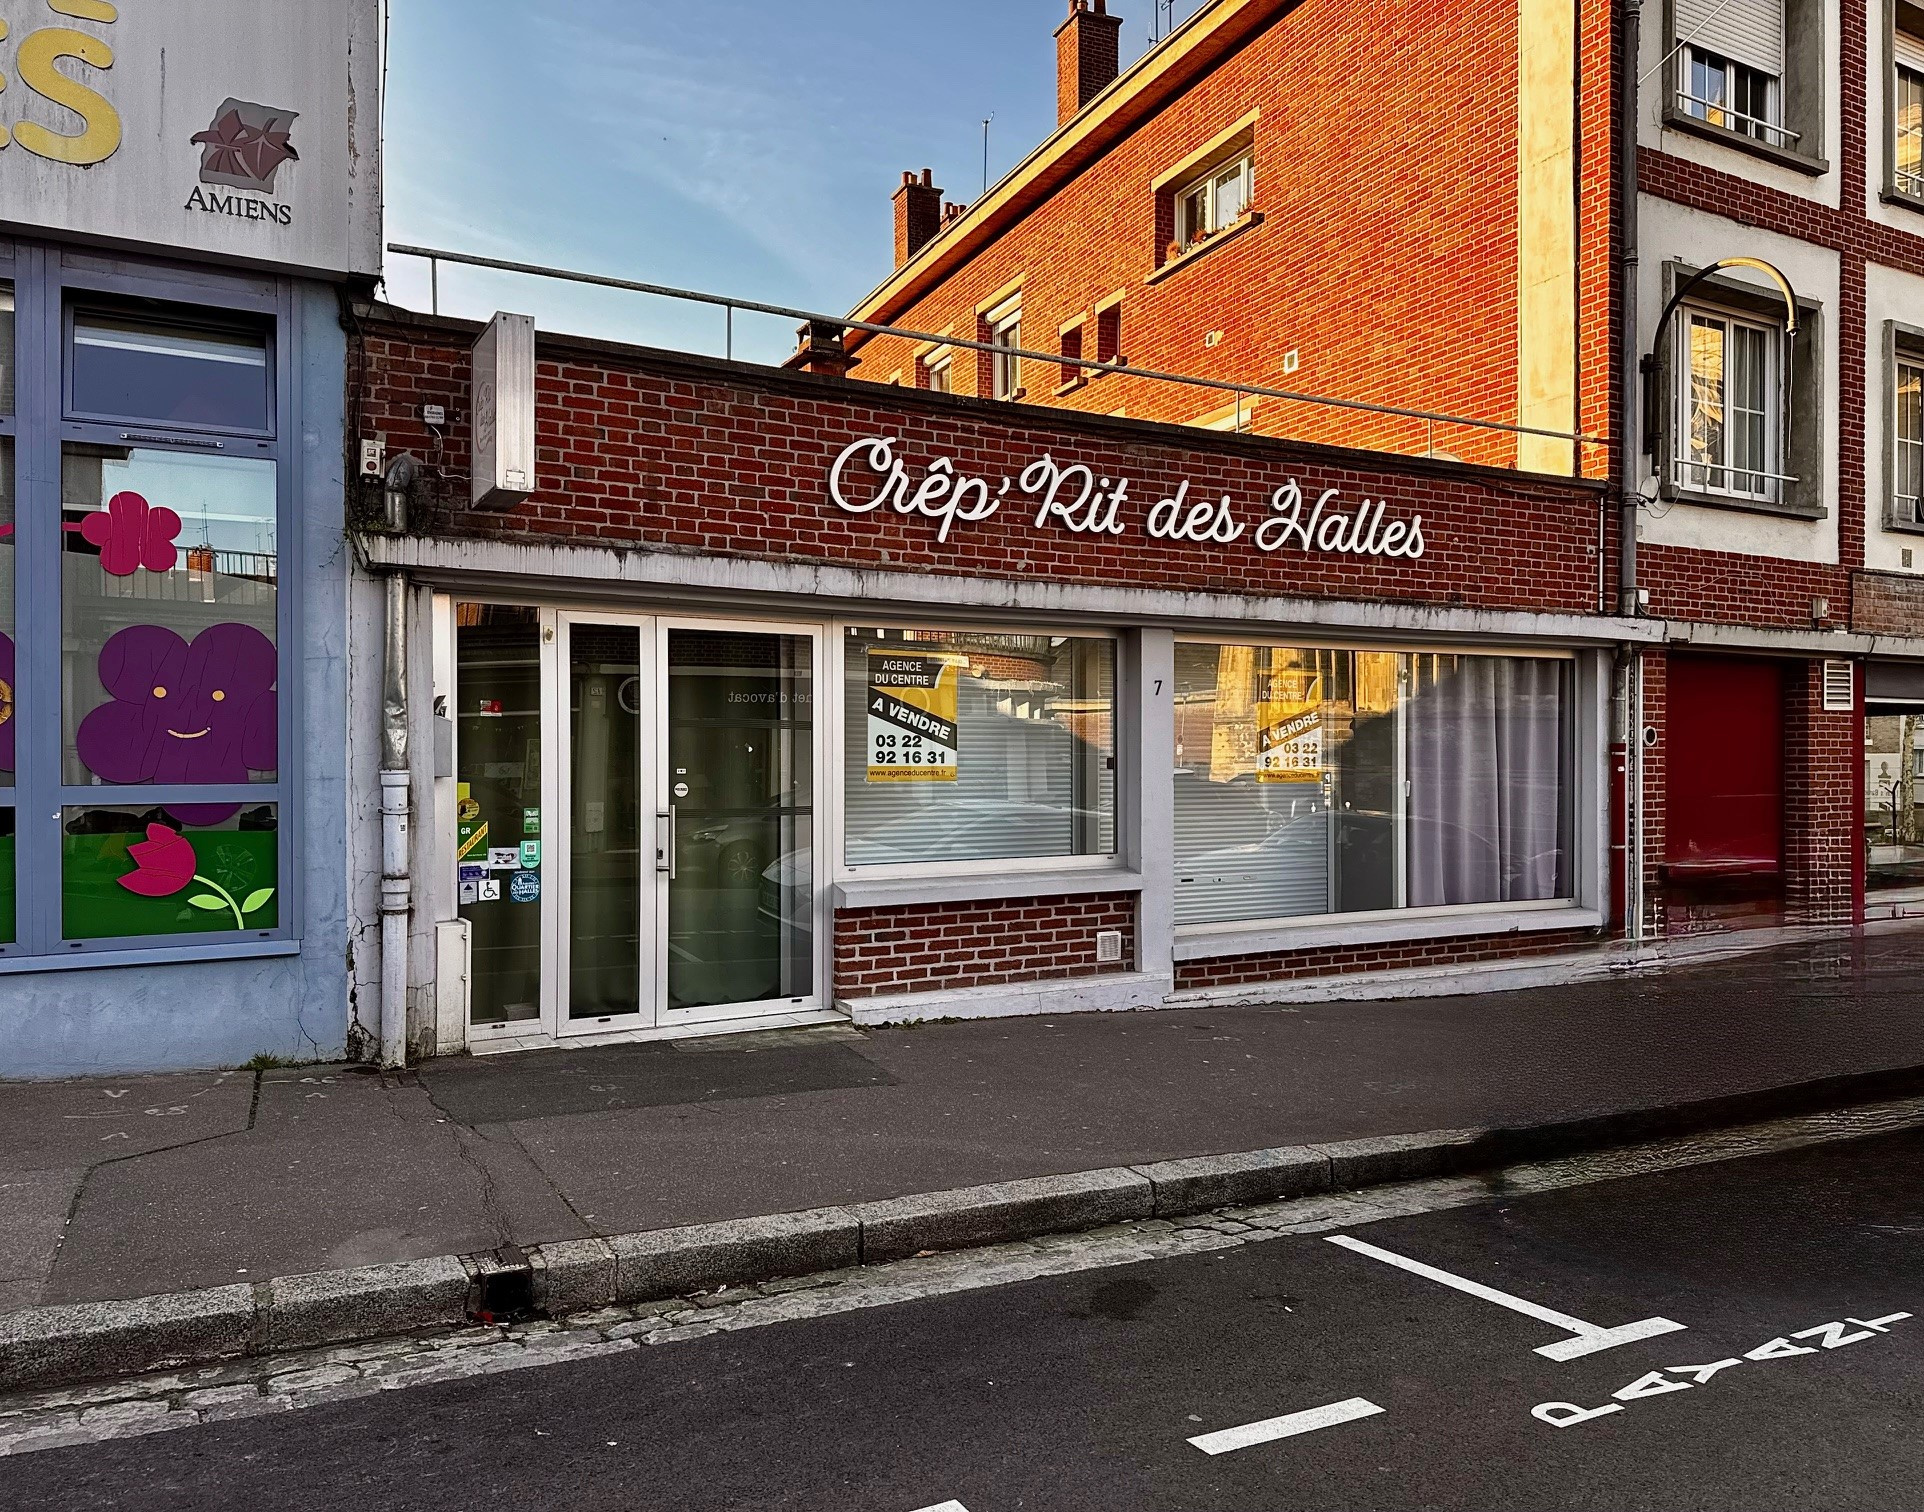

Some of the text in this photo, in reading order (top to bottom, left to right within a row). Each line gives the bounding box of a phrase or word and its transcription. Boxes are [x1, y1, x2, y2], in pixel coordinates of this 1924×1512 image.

[1146, 479, 1246, 542] des
[1254, 477, 1425, 559] Halles
[882, 660, 922, 672] AGENCE
[875, 673, 929, 686] DU CENTRE
[1267, 679, 1298, 689] AGENCE
[1154, 679, 1163, 696] 7
[1262, 690, 1303, 701] DU CENTRE
[872, 697, 951, 740] A VENDRE
[1262, 711, 1320, 747] A VENDRE
[875, 734, 922, 748] 03 22
[1284, 742, 1318, 754] 03 22
[875, 751, 945, 764] 92 16 31
[1264, 756, 1317, 768] 92 16 31
[869, 769, 947, 778] www.agenceducentre.fr
[460, 827, 471, 835] GR
